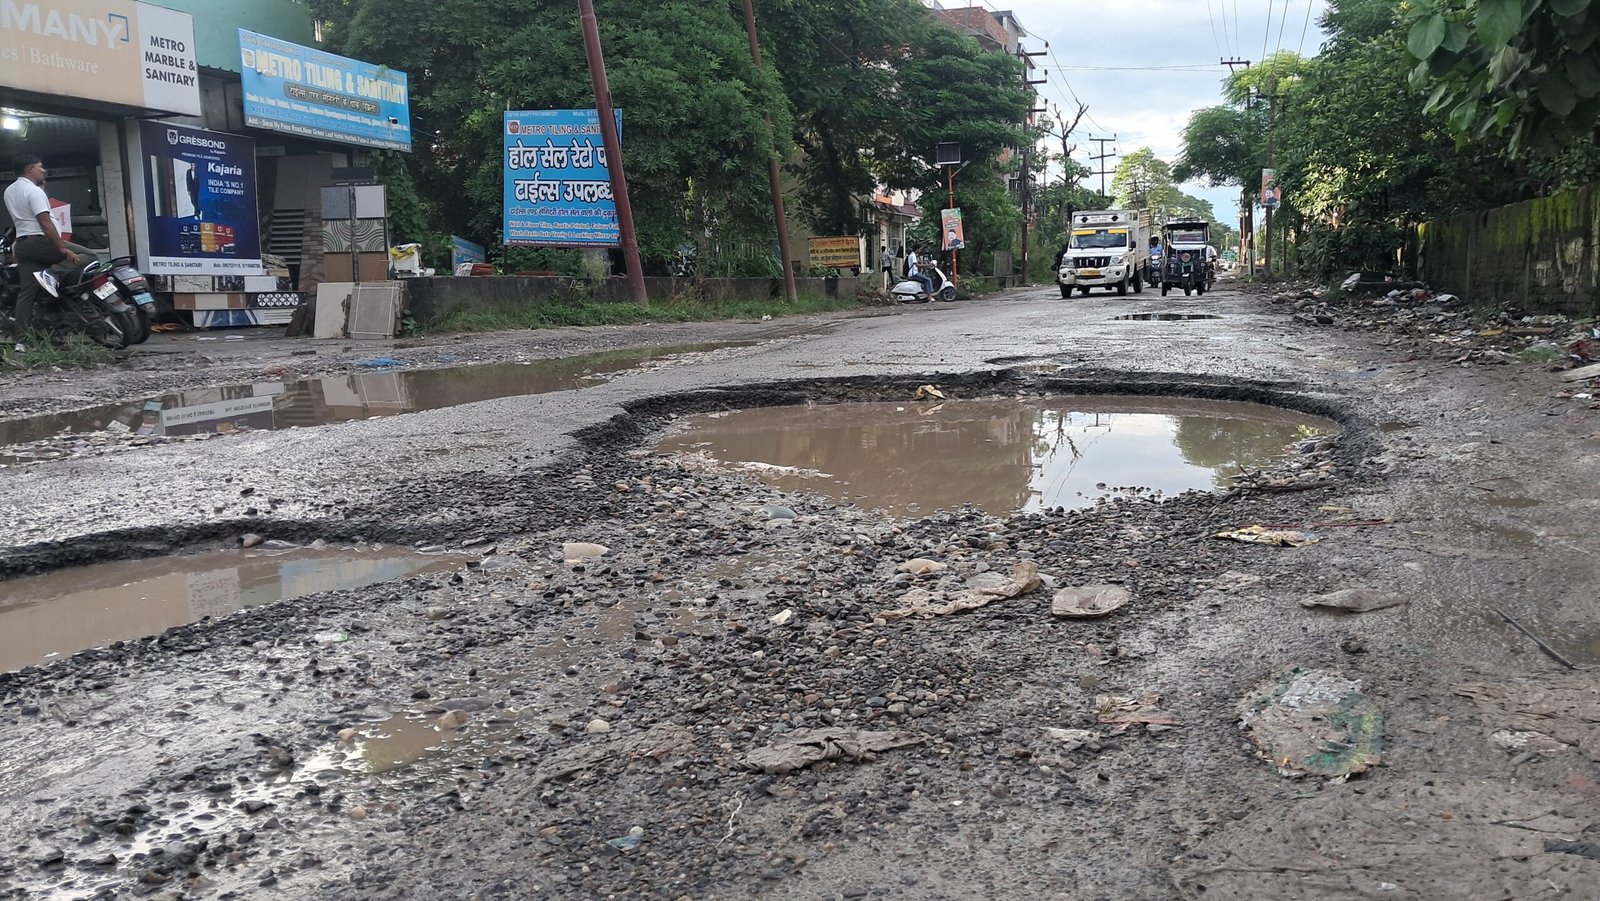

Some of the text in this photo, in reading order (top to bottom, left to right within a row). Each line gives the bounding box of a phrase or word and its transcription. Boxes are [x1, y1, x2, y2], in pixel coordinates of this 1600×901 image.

[150, 35, 185, 52] METRO
[29, 46, 99, 74] Bathware
[145, 51, 196, 71] MARBLE &
[145, 68, 195, 87] SANITARY
[256, 48, 302, 82] METRO
[304, 61, 342, 92] TILING
[346, 72, 354, 94] &
[356, 74, 406, 105] SANITARY
[521, 124, 546, 134] METRO
[548, 124, 572, 134] TILING
[574, 124, 579, 134] &
[581, 124, 600, 134] SANI
[508, 138, 538, 169] होल
[540, 138, 569, 168] सेल
[570, 138, 594, 169] रेटो
[208, 162, 242, 176] Kajaria
[514, 172, 560, 203] टाईल्स
